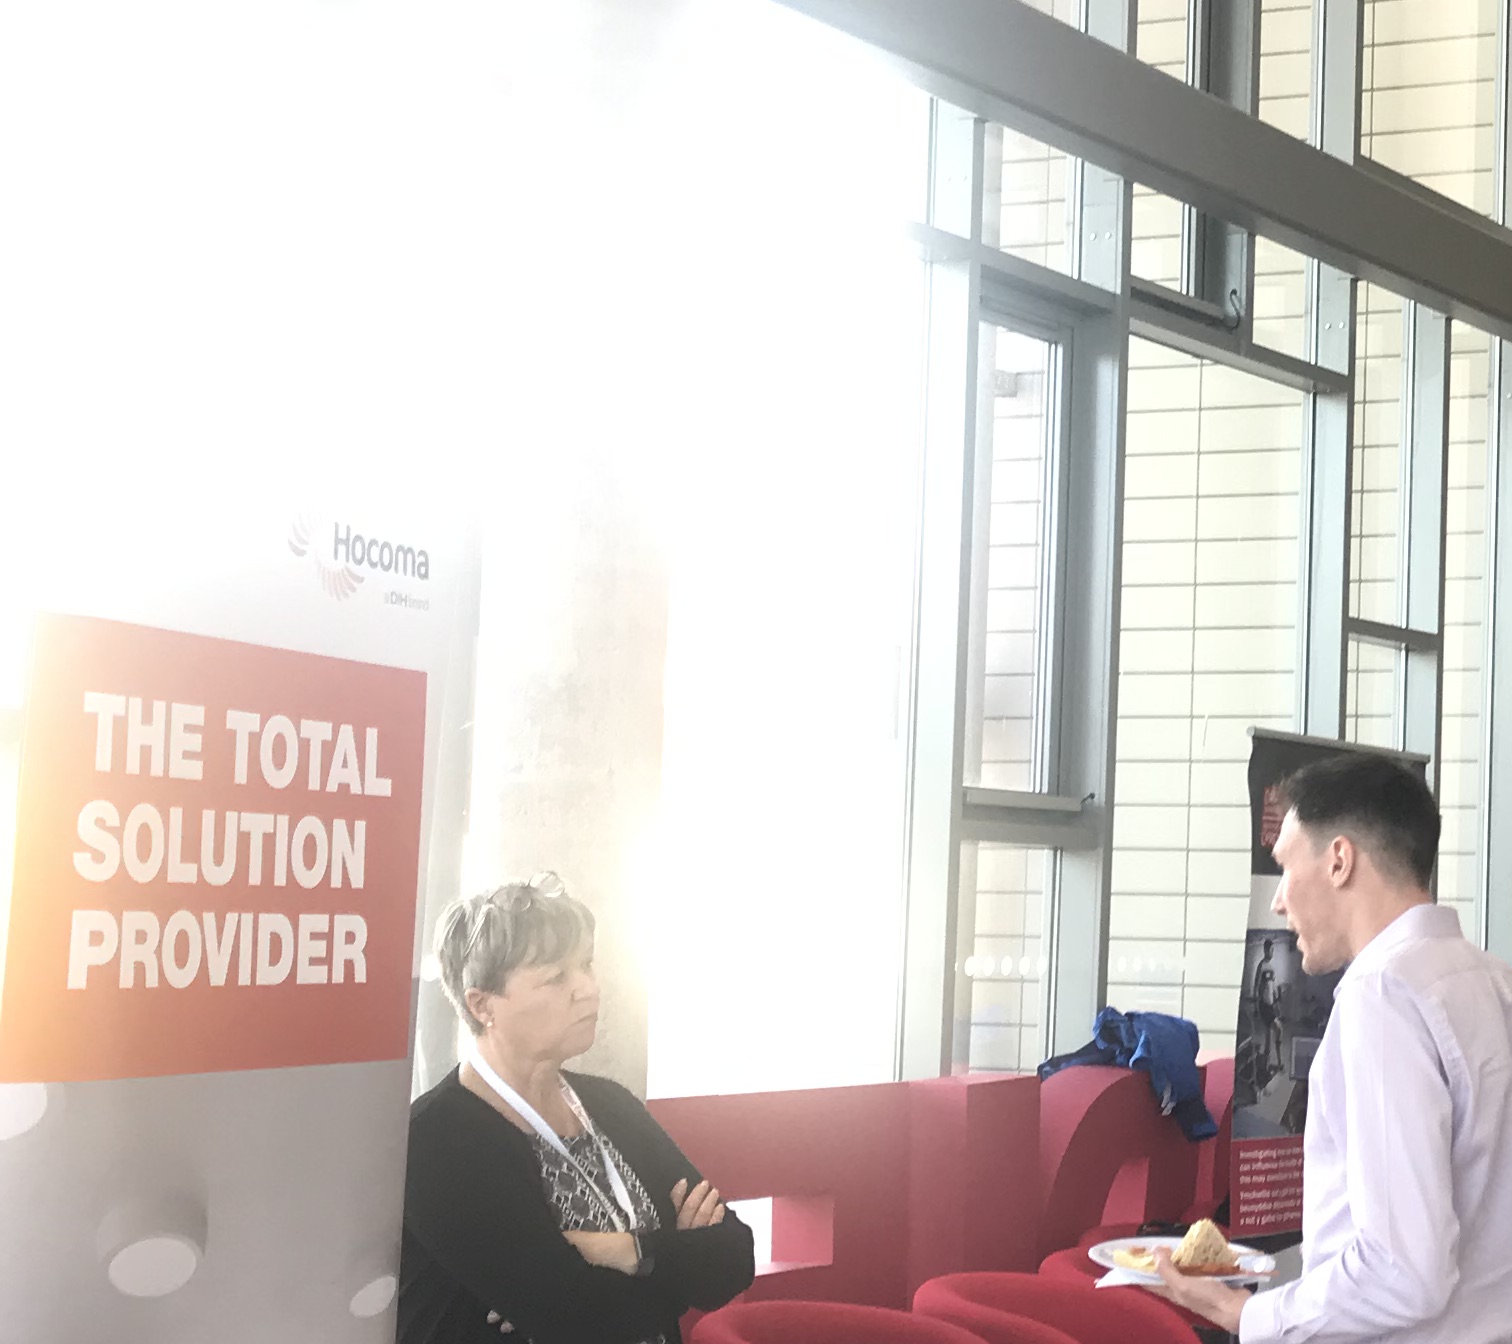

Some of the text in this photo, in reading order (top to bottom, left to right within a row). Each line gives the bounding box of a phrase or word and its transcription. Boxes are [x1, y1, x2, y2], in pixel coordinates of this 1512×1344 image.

[333, 521, 430, 581] Hocoma
[83, 691, 392, 798] THE TOTAL
[72, 799, 366, 890] SOLUTION
[66, 909, 368, 990] PROVIDER
